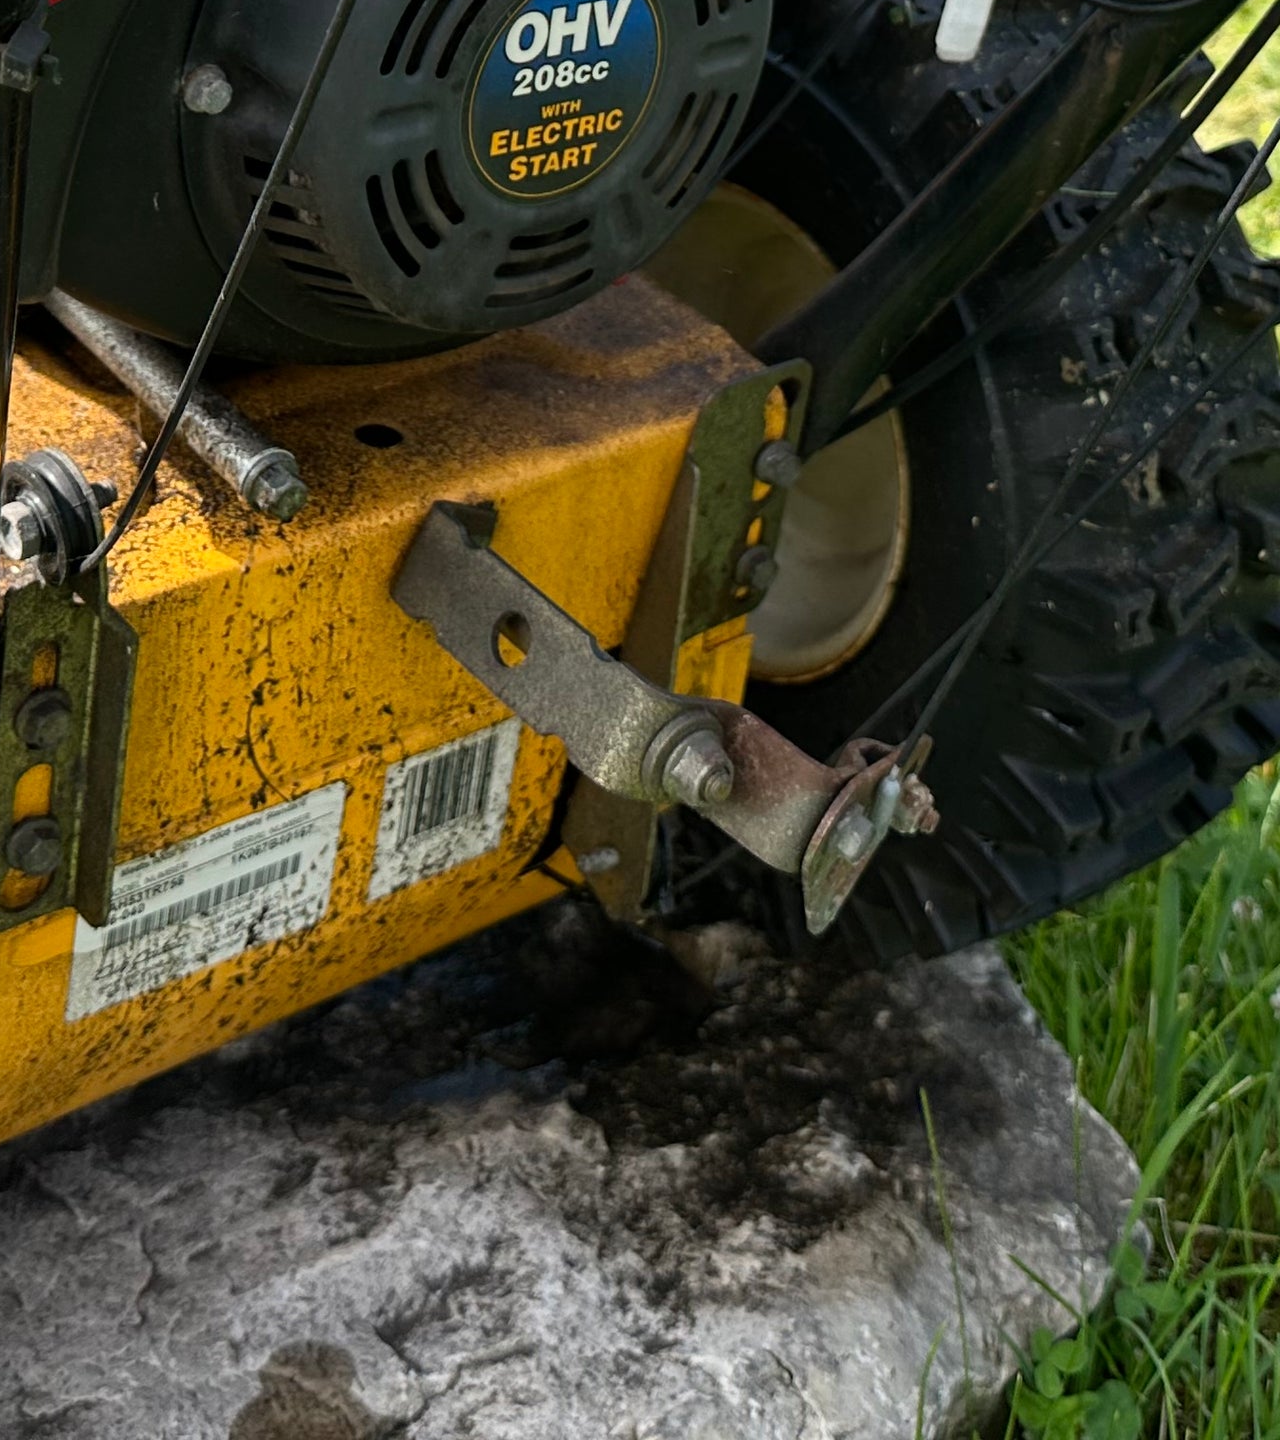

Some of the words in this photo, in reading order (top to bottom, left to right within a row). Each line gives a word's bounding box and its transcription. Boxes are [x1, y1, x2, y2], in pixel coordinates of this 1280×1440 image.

[512, 60, 610, 97] 208cc
[541, 99, 582, 120] WITH
[489, 108, 624, 157] ELECTRIC
[508, 143, 598, 182] START
